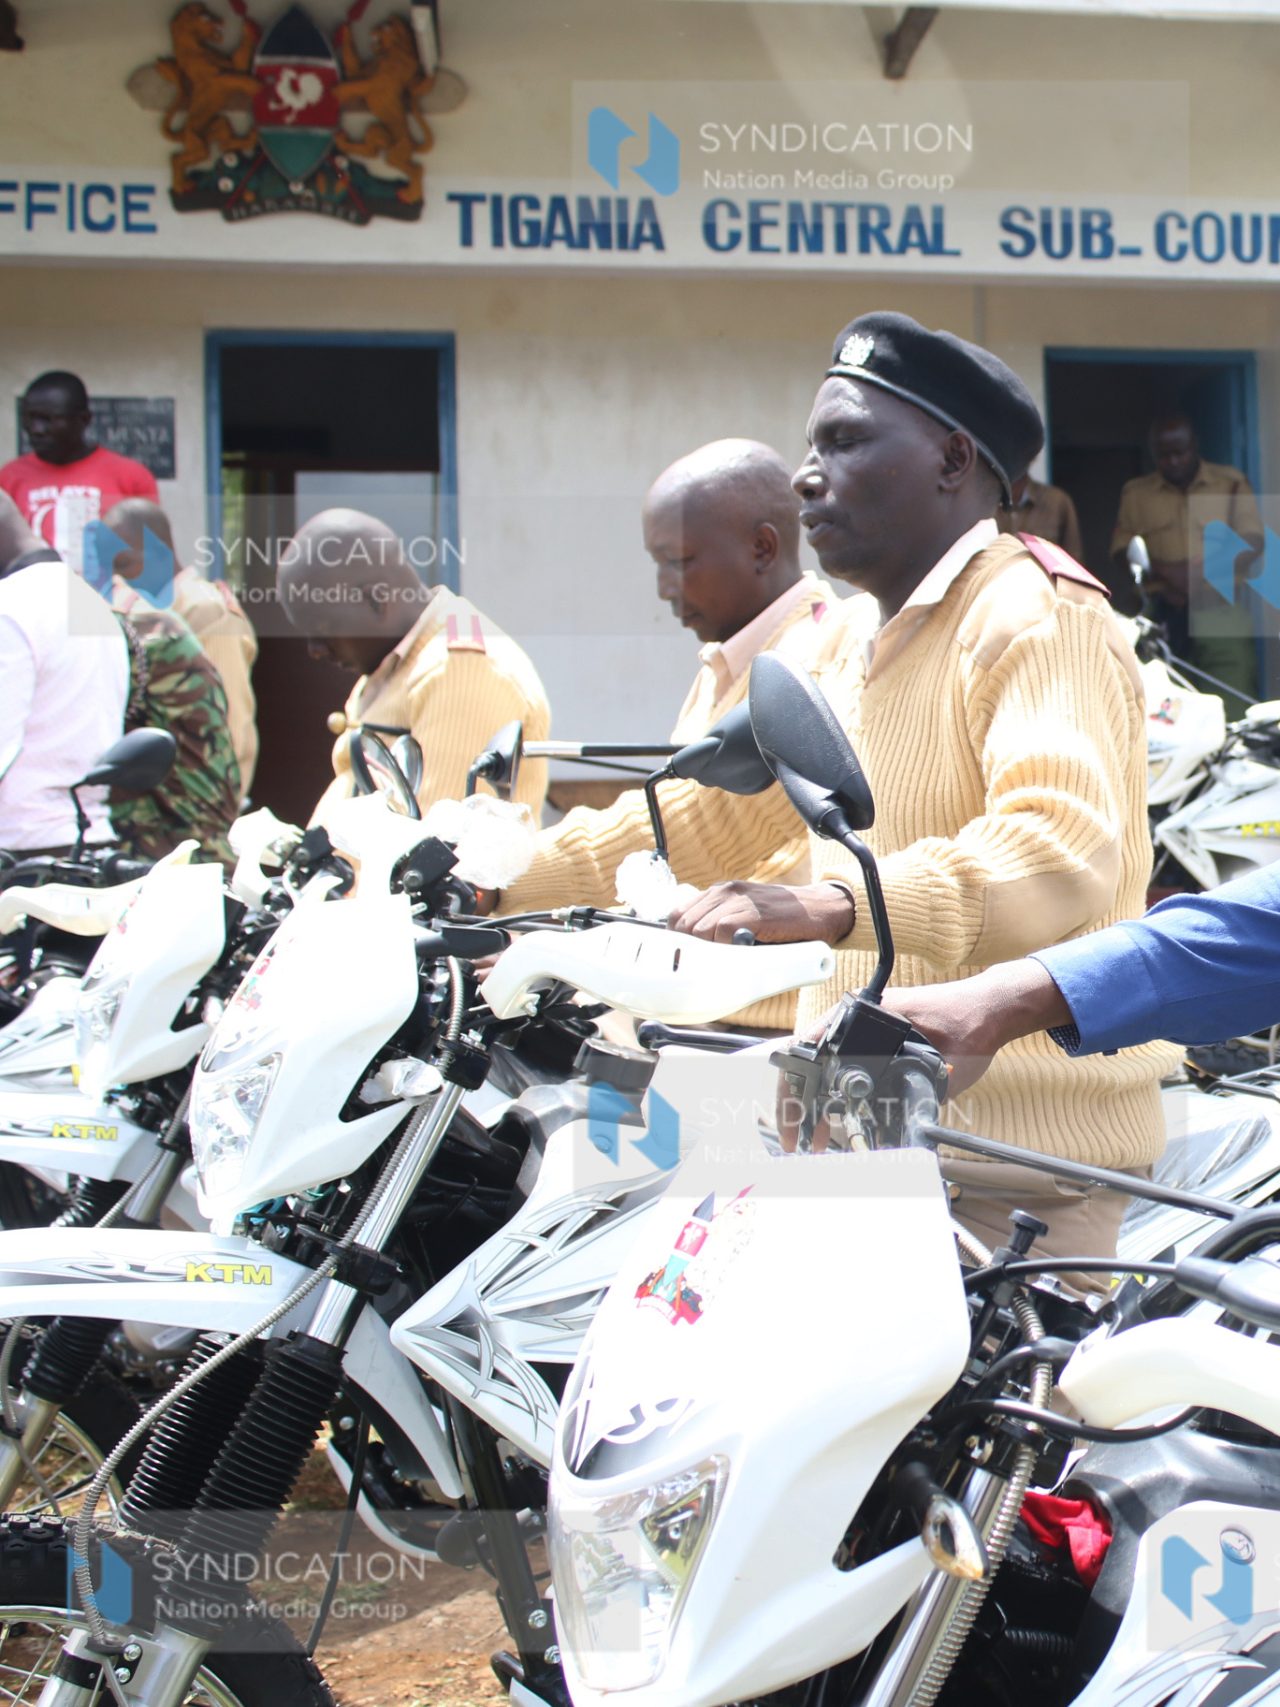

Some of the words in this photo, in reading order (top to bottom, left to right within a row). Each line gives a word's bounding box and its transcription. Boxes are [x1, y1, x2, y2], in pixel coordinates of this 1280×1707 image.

[446, 192, 667, 252] TIGANIA
[702, 197, 962, 257] CENTRAL
[52, 1123, 118, 1141] KTM
[186, 1262, 273, 1286] KTM
